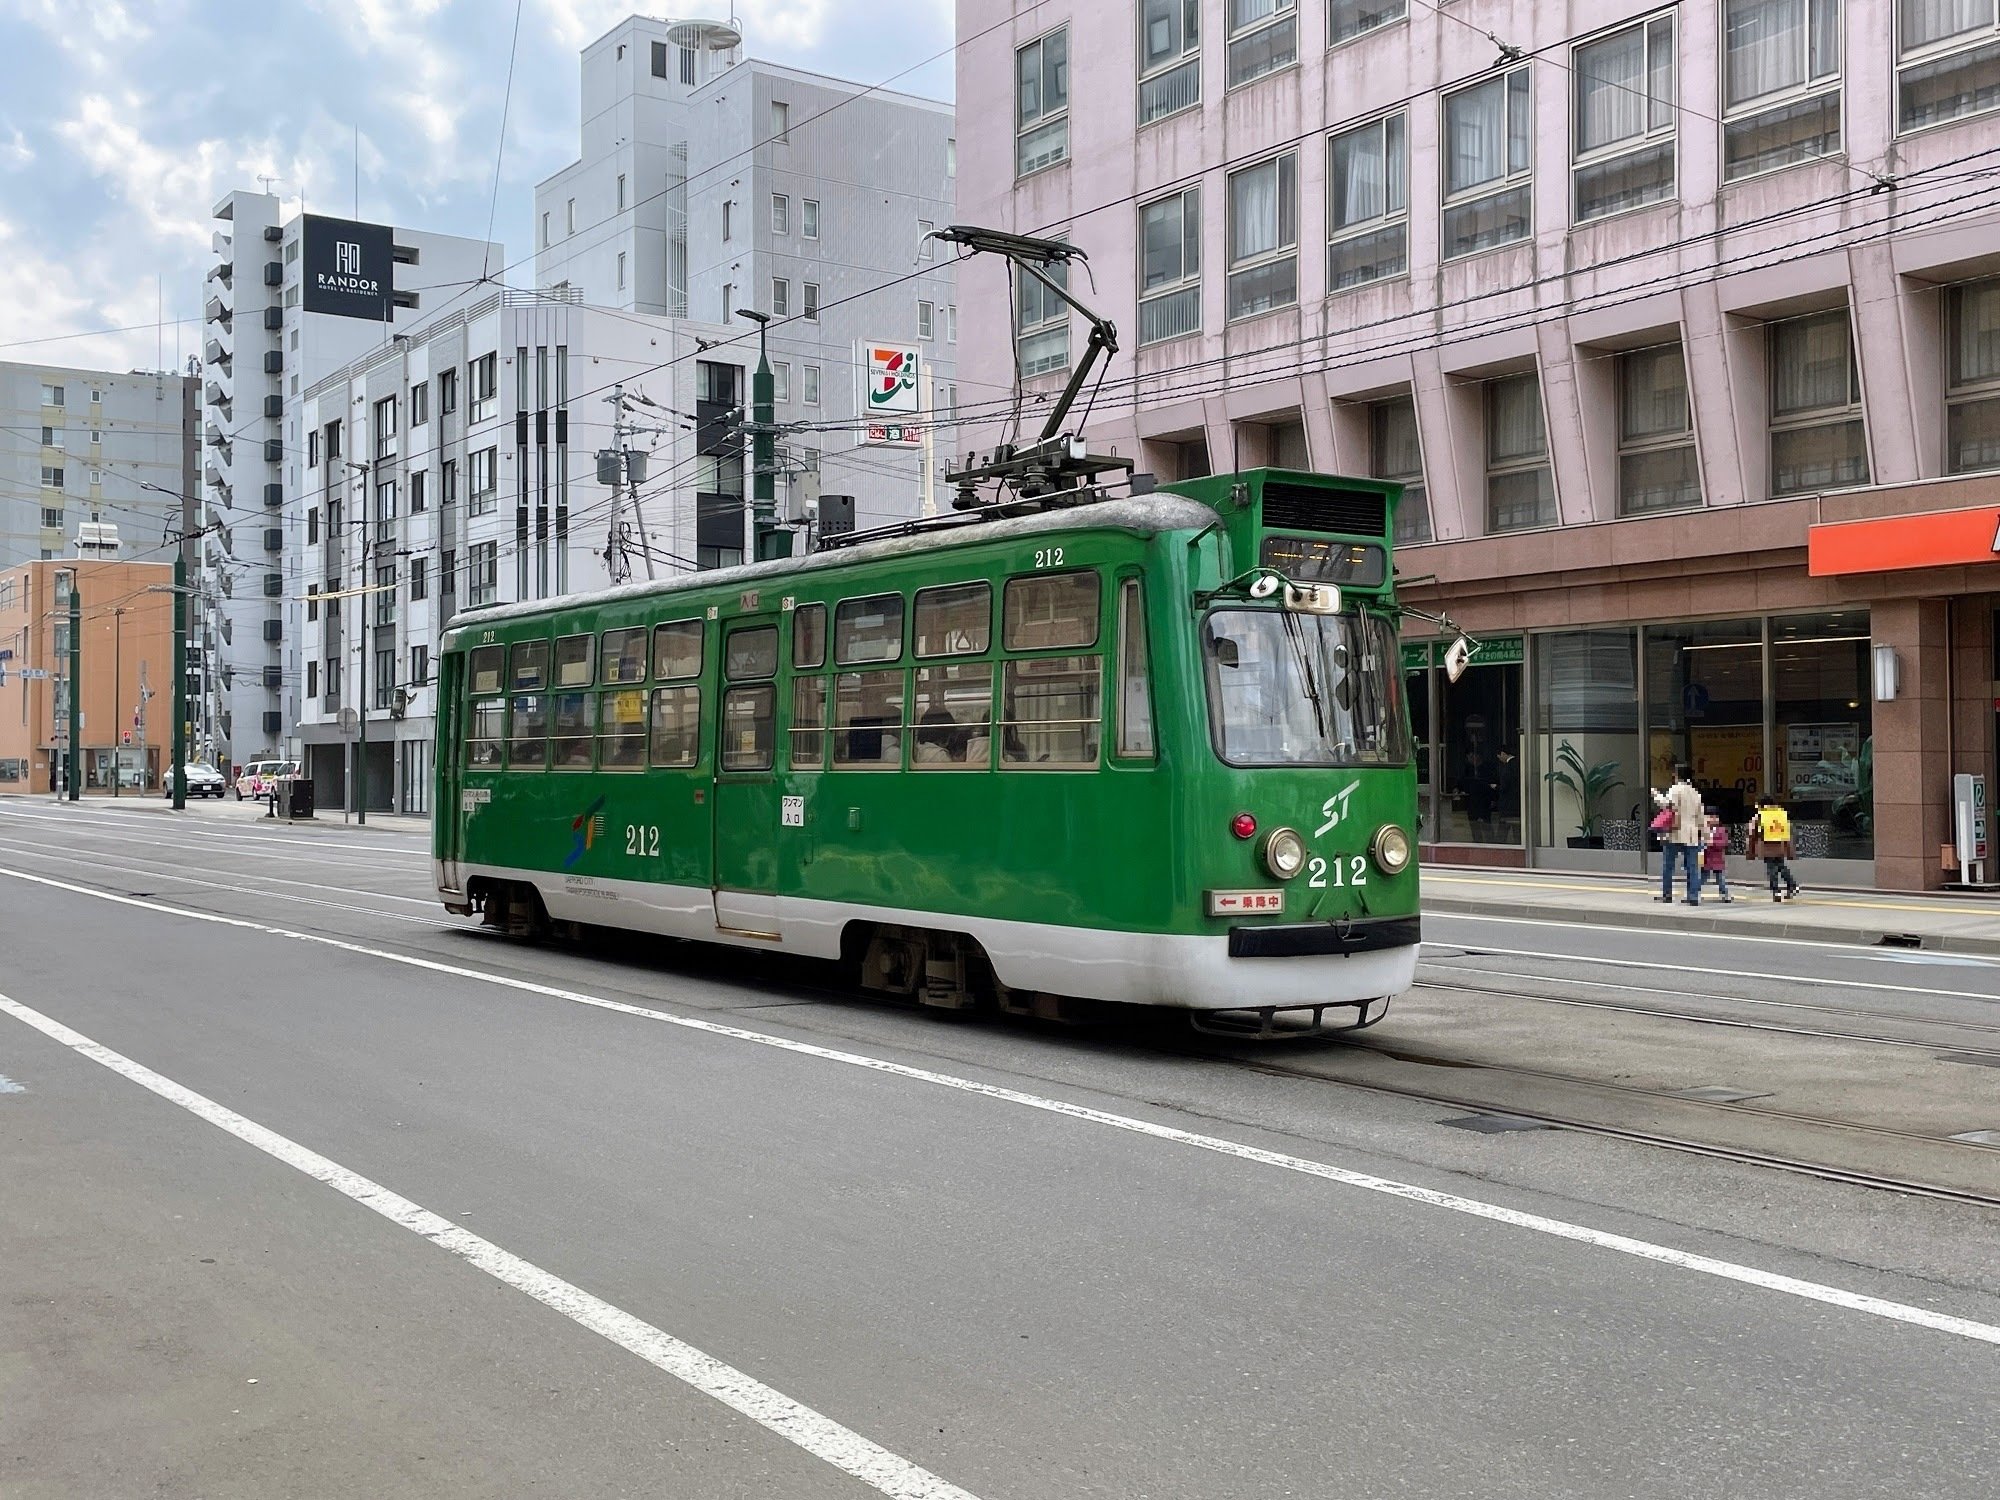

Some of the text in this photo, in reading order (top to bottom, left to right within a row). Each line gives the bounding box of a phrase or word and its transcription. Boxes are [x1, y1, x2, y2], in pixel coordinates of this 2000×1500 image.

[318, 273, 378, 291] RANDOR
[1035, 547, 1064, 568] 212
[482, 630, 495, 643] 212
[783, 797, 803, 807] ワンマン
[785, 813, 800, 824] 入口
[626, 825, 660, 856] 212
[1308, 855, 1367, 888] 212
[1242, 895, 1279, 908] 乗降中
